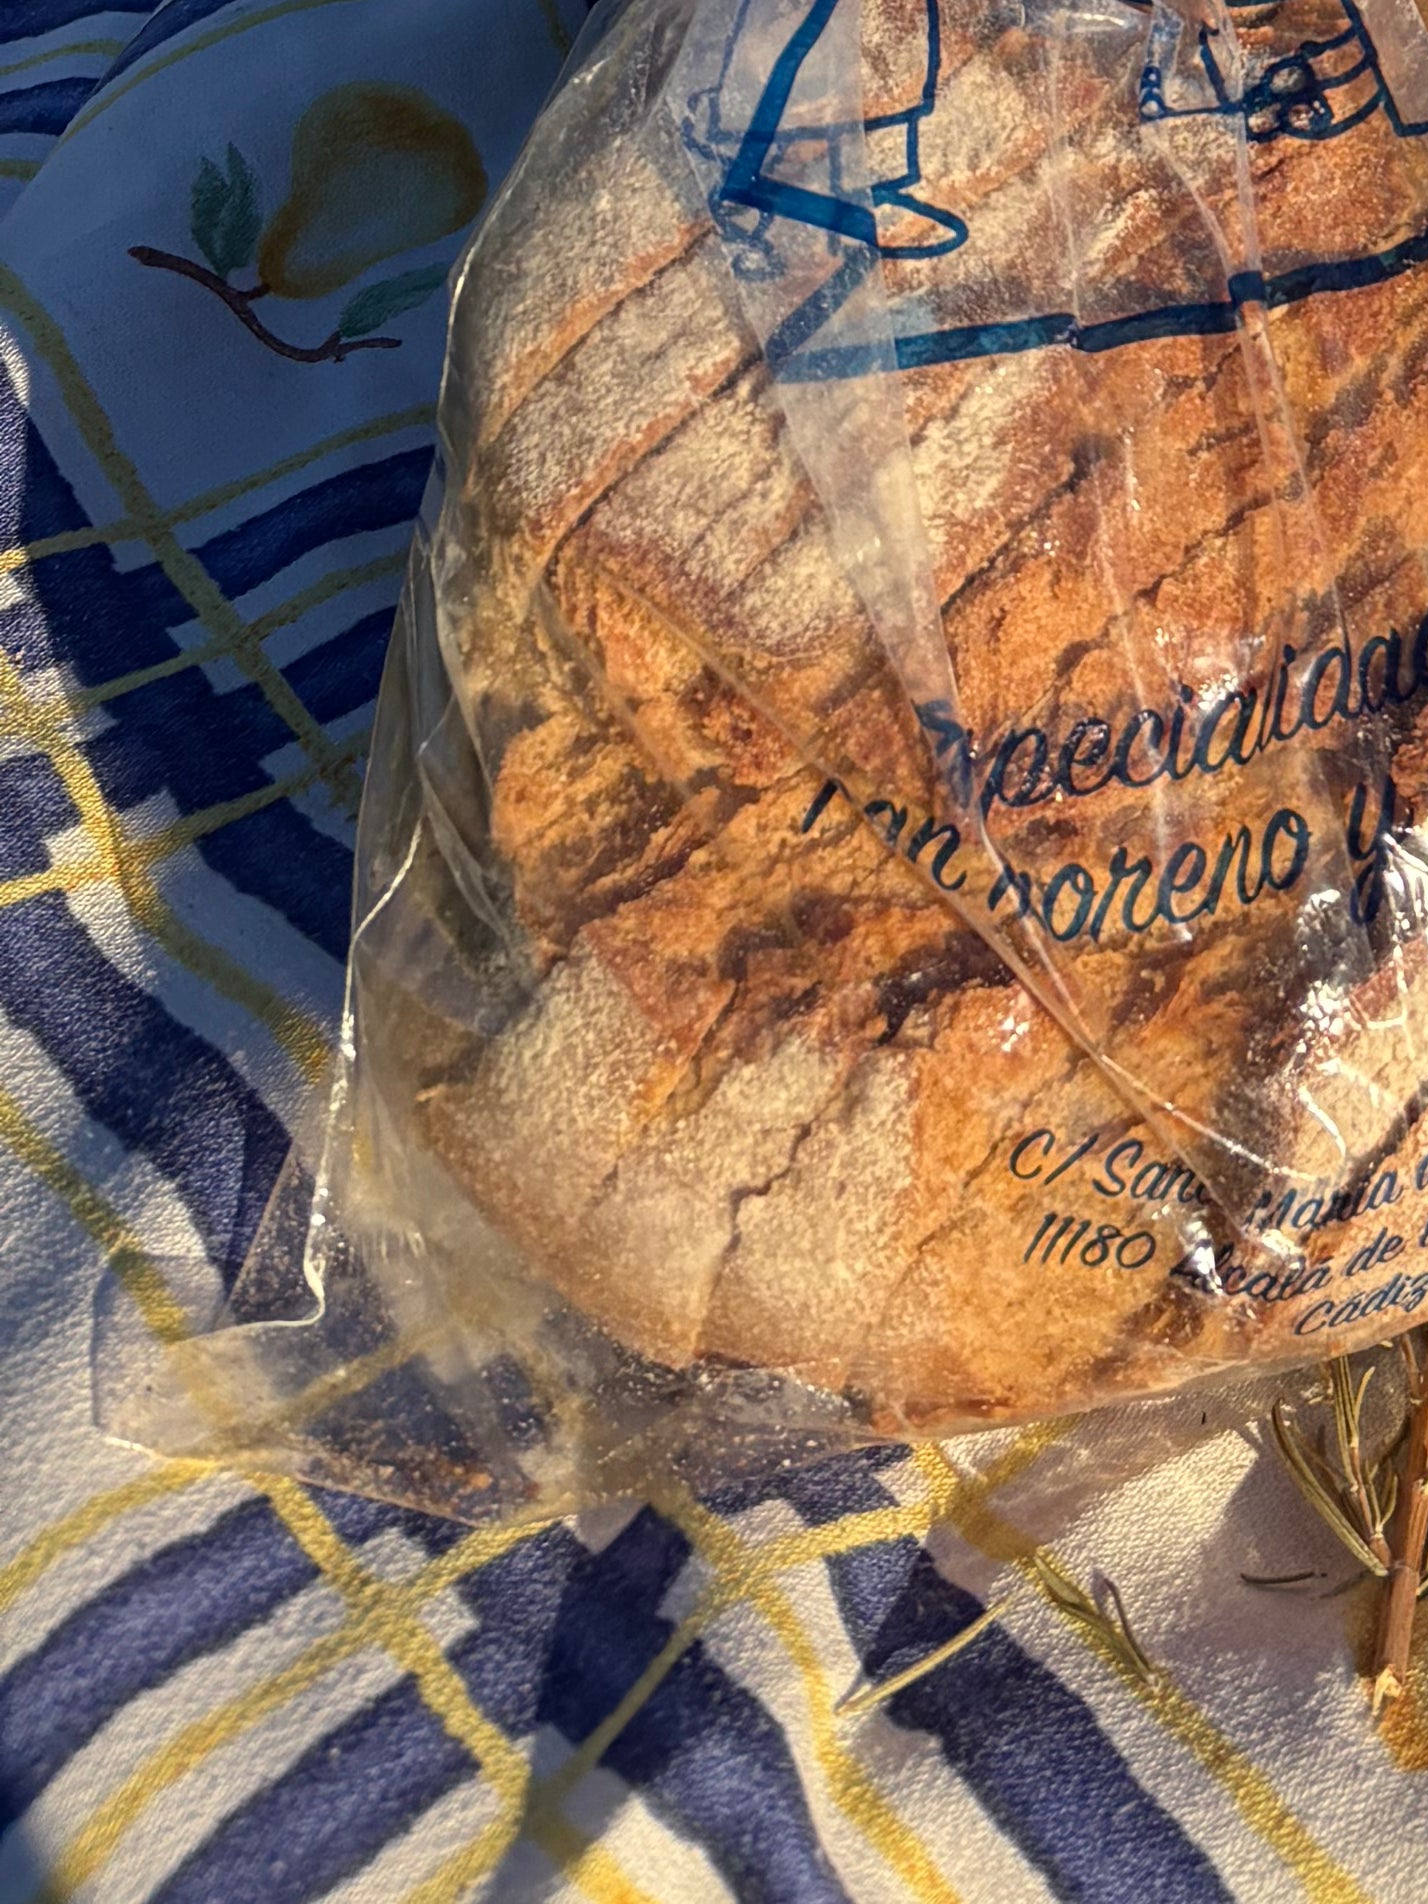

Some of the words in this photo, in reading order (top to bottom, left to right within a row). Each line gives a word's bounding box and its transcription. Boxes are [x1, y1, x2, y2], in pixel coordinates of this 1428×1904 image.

[1347, 775, 1413, 927] y
[1009, 1128, 1100, 1185] C/
[1023, 1212, 1157, 1270] 11180
[1346, 1227, 1406, 1277] de
